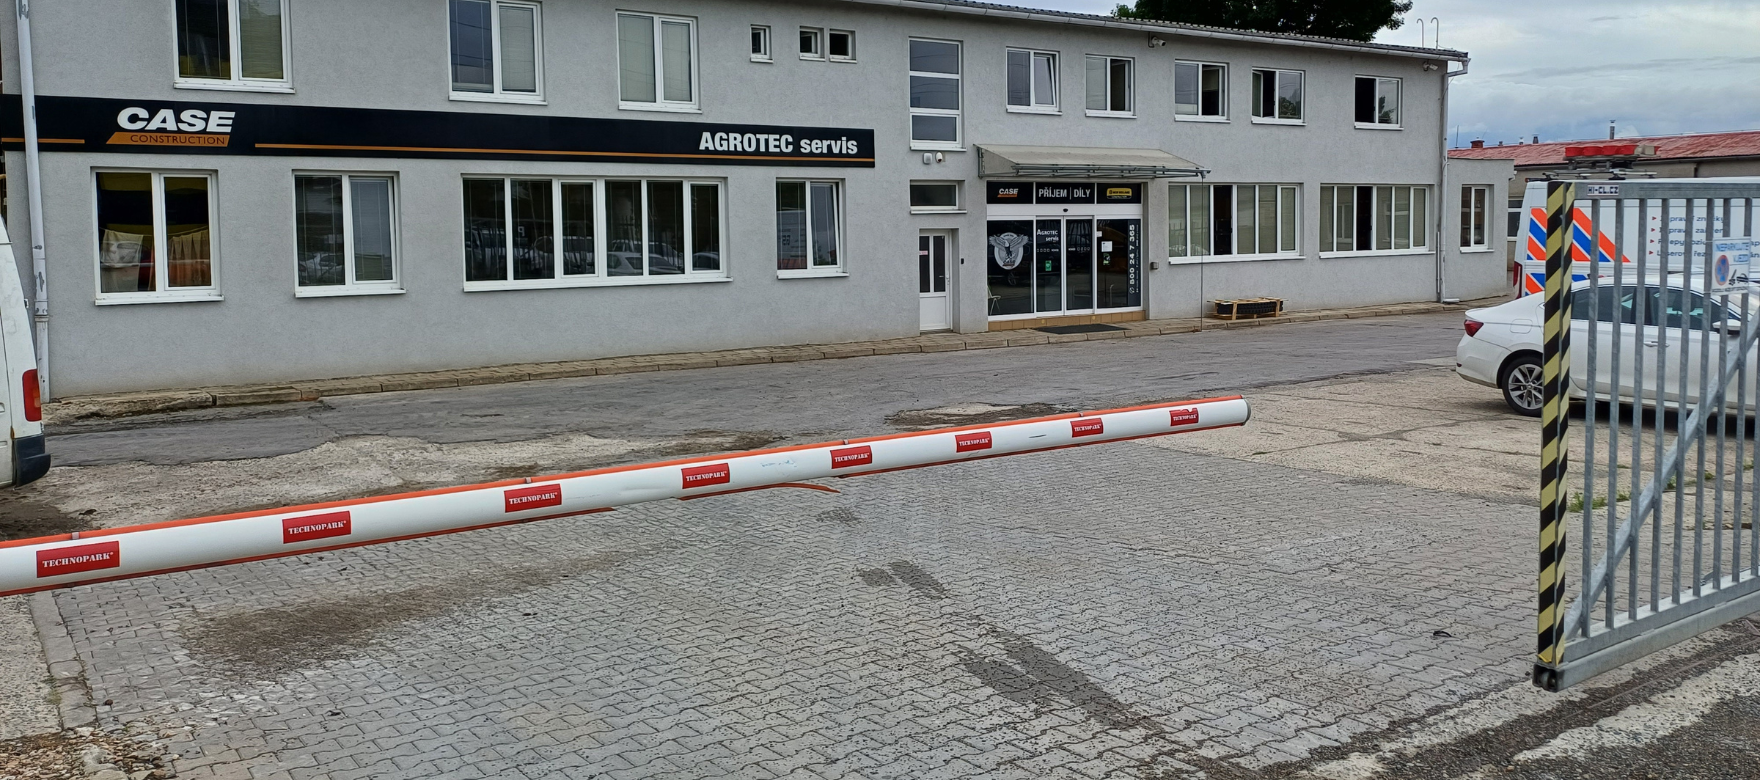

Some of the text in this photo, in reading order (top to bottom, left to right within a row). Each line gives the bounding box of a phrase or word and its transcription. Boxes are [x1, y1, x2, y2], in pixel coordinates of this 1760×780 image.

[117, 107, 236, 132] CASE
[130, 134, 225, 145] CONSTRUCTION
[699, 132, 858, 154] AGROTEC servis
[1038, 187, 1091, 198] PŘÍJEM DÍLY
[1129, 253, 1135, 265] 24
